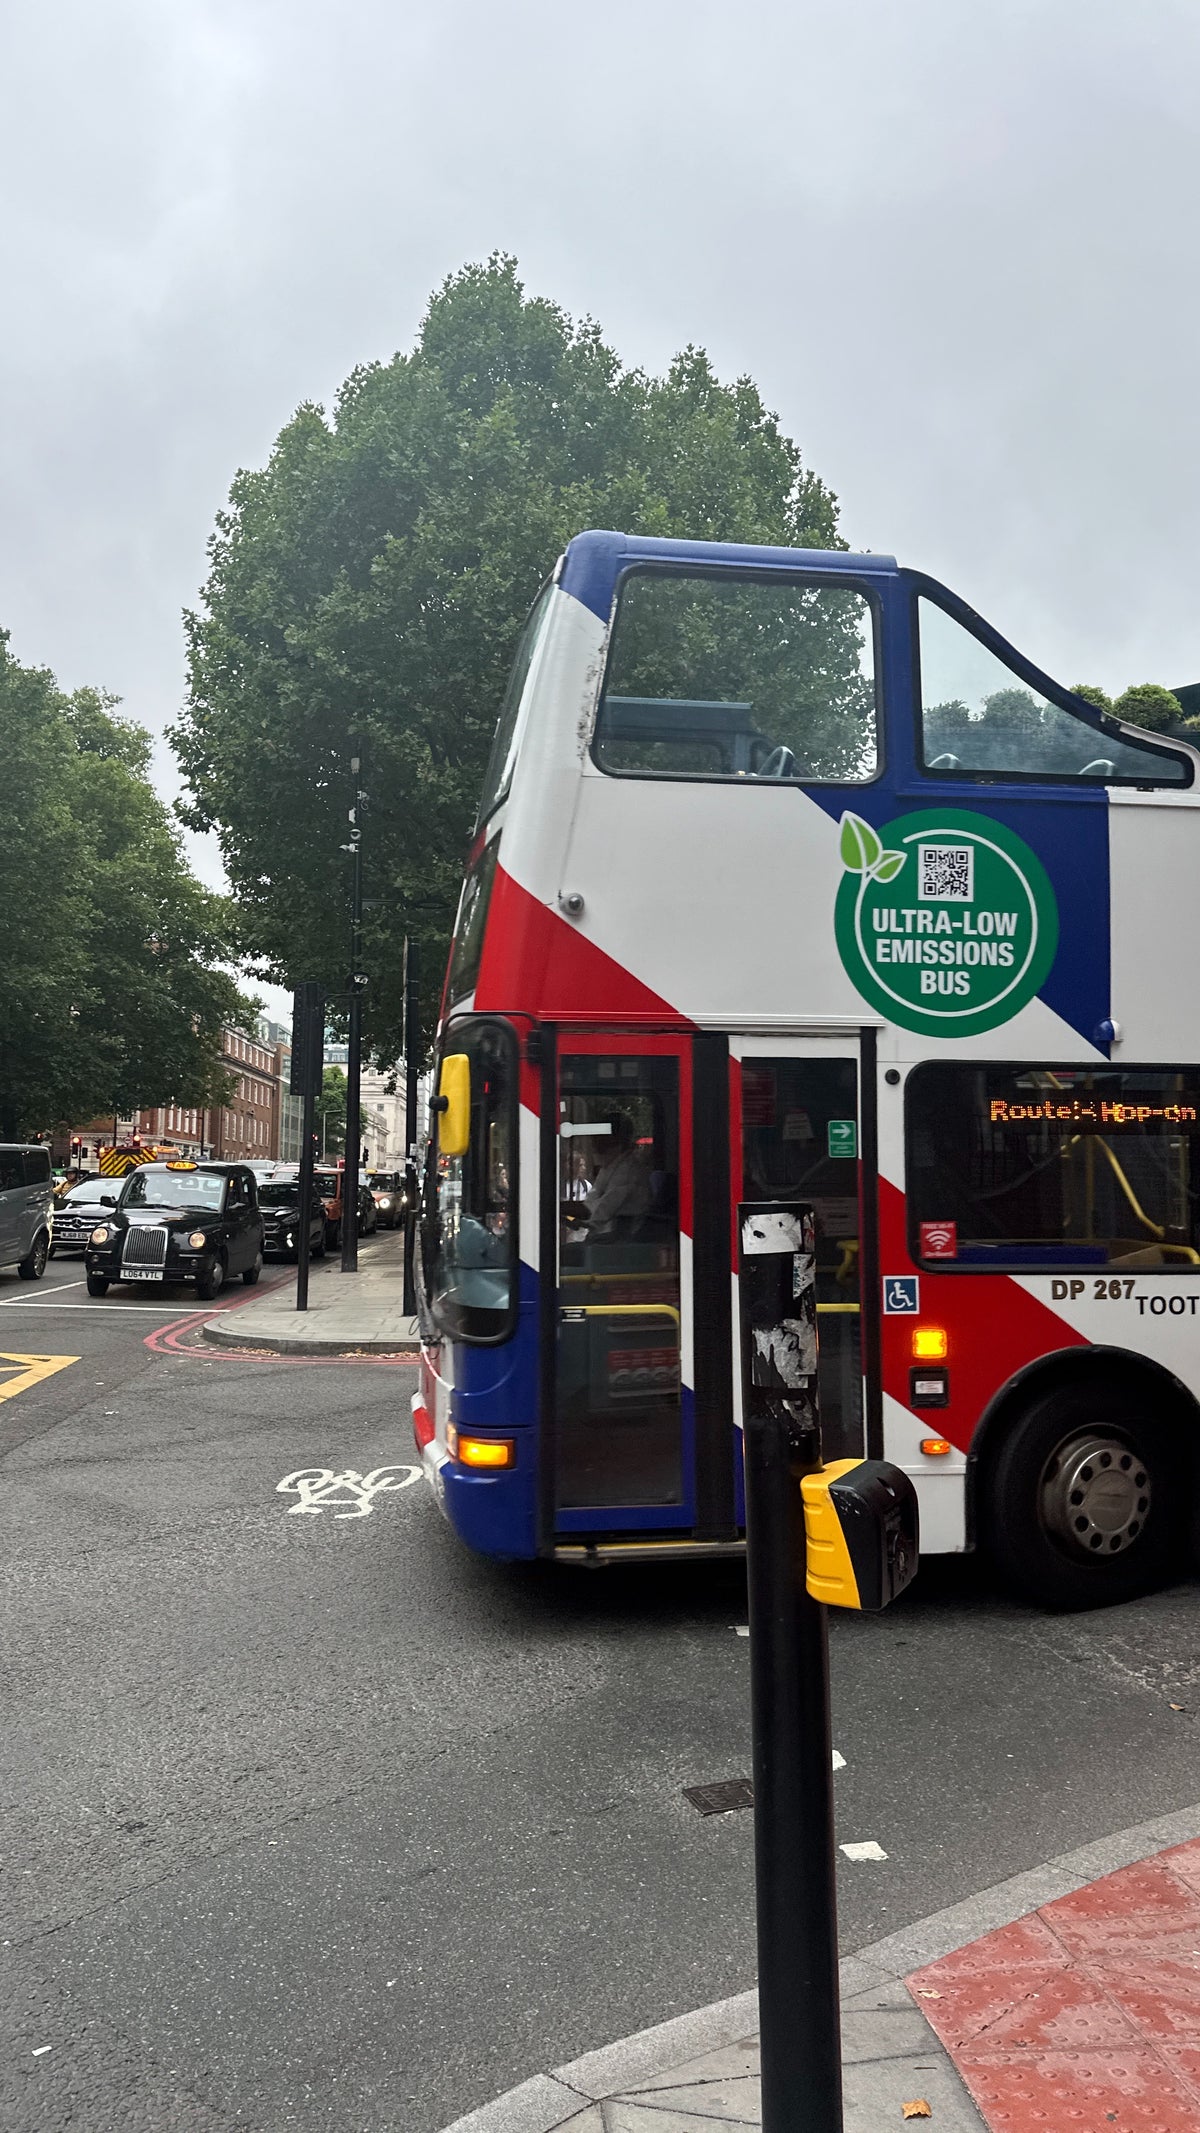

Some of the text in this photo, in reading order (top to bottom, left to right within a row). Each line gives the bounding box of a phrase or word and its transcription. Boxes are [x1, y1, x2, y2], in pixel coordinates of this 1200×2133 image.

[872, 908, 1018, 936] ULTRA-LOW
[876, 938, 1015, 967] EMISSIONS
[920, 970, 971, 996] BUS
[123, 1270, 160, 1280] LO64 VTL
[1051, 1279, 1136, 1300] DP 267
[1135, 1295, 1200, 1315] TOOT
